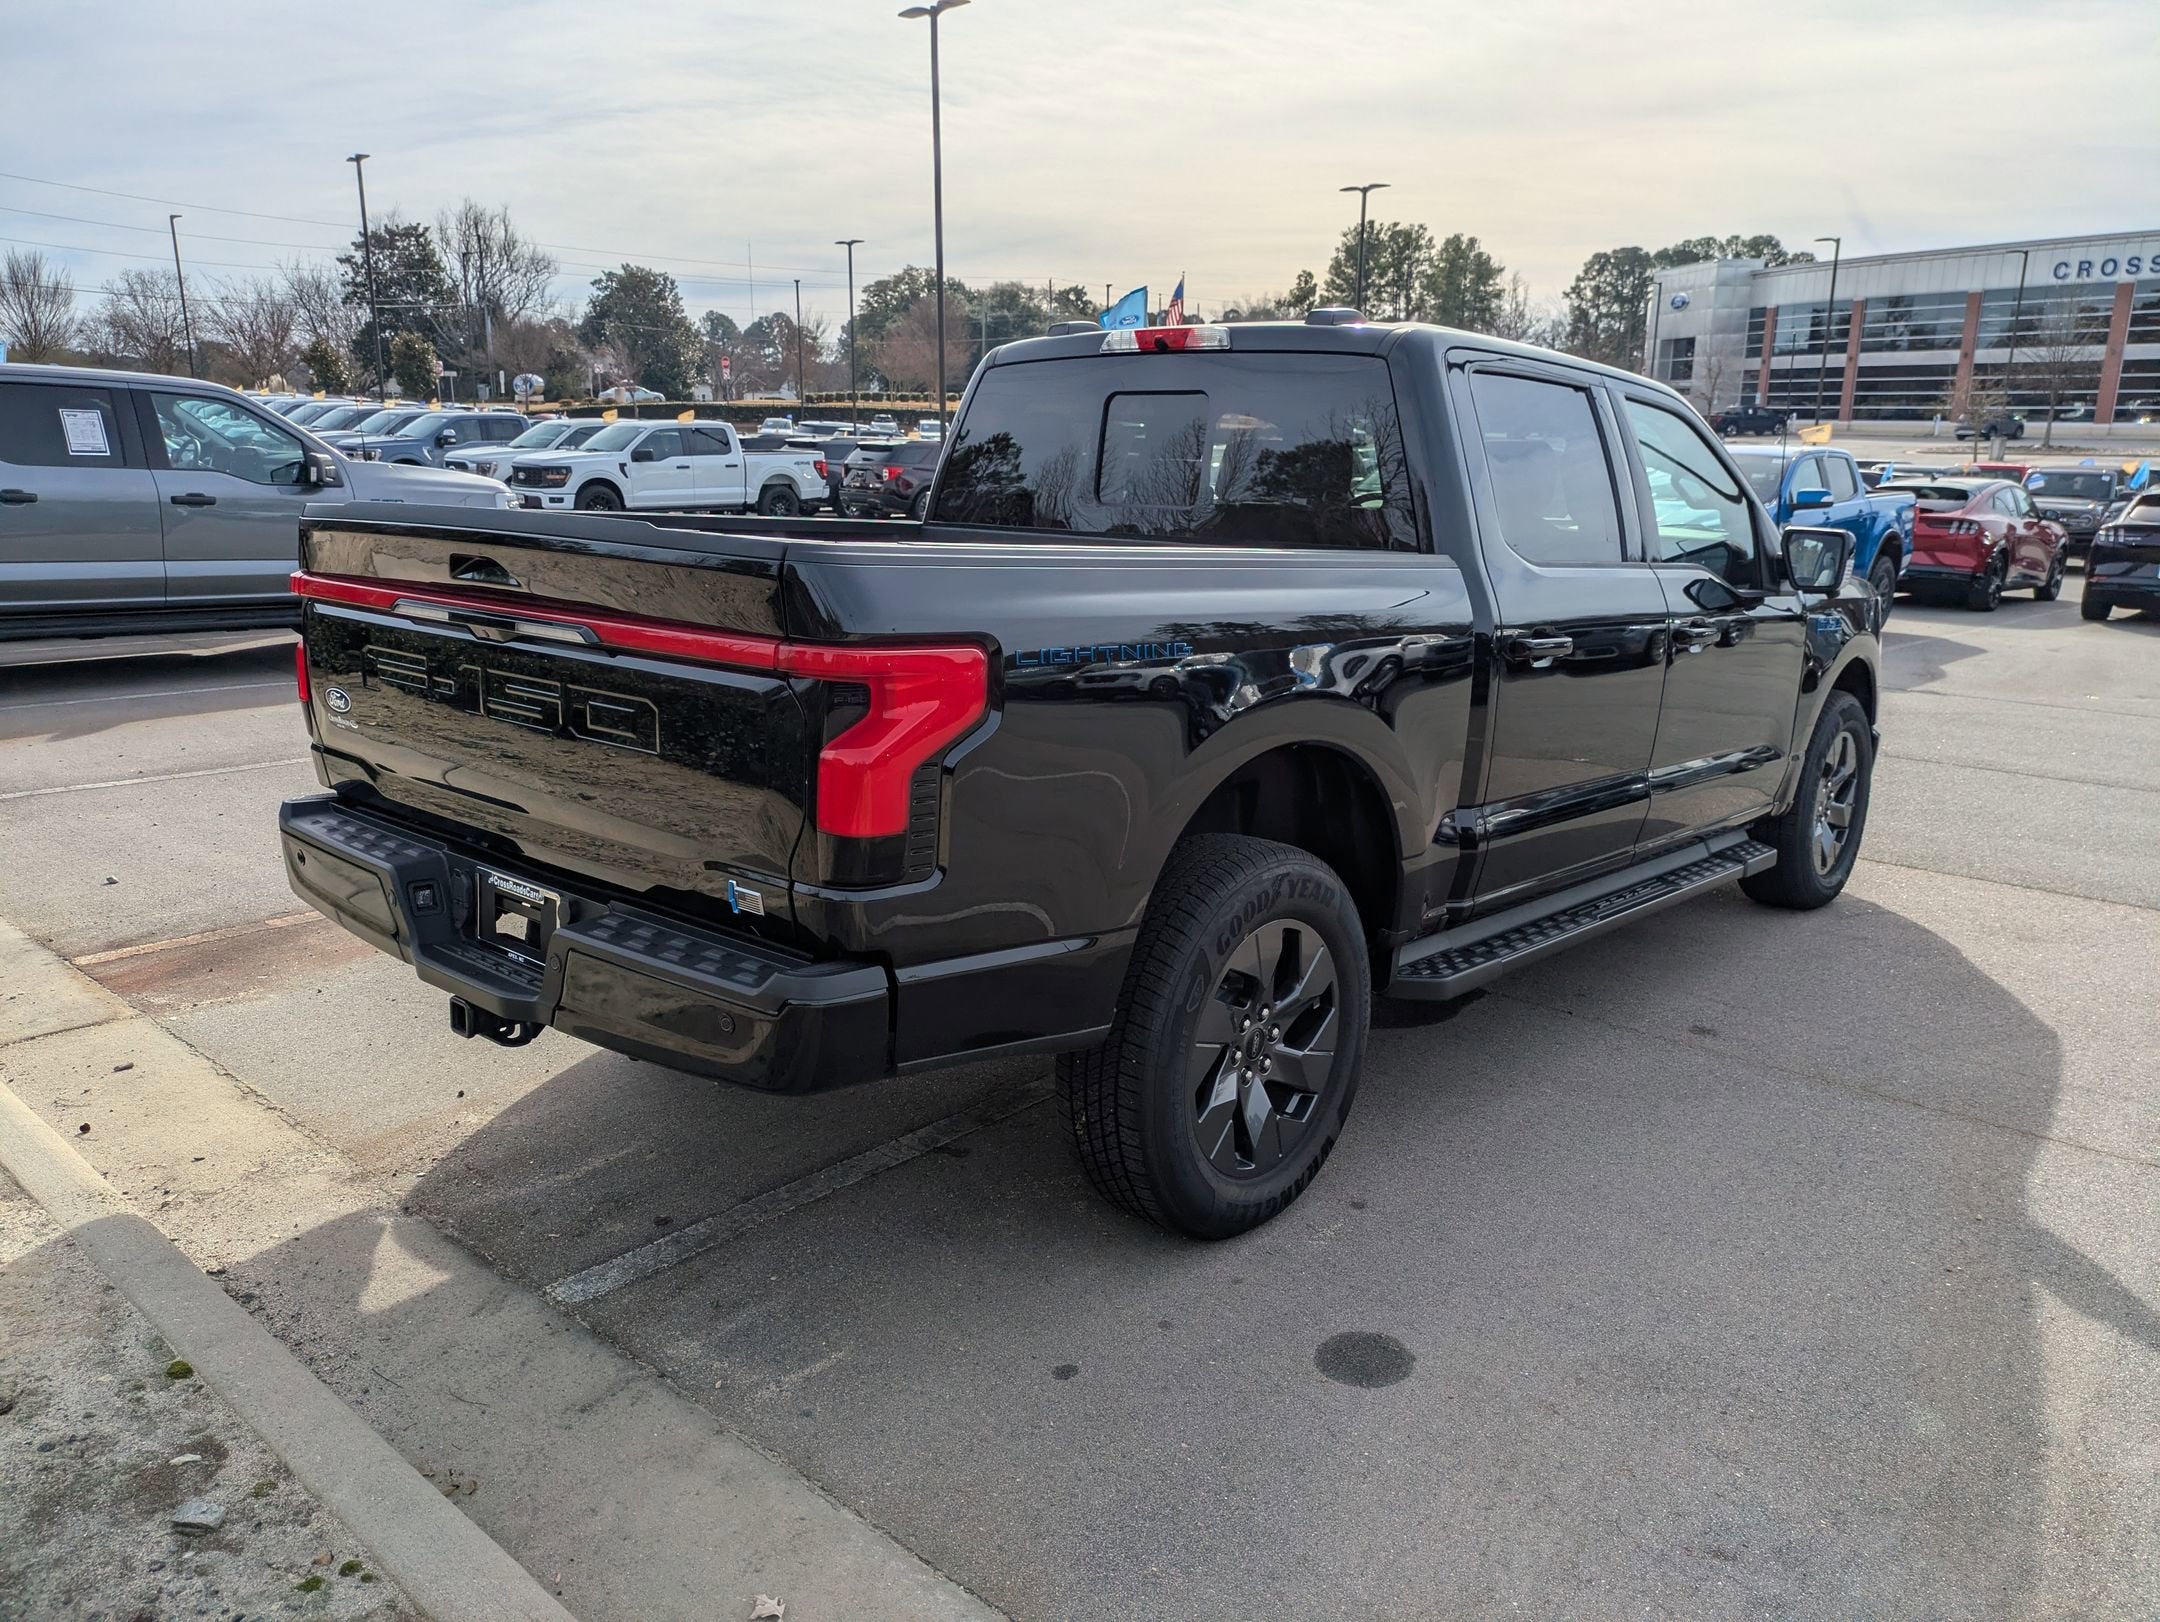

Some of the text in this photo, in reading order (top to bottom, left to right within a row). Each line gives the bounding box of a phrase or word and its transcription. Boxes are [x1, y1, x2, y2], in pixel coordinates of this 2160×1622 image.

[2053, 255, 2160, 280] CROSS
[1014, 642, 1193, 666] LIGHTNING
[328, 689, 348, 710] Ford
[360, 645, 660, 755] F-150
